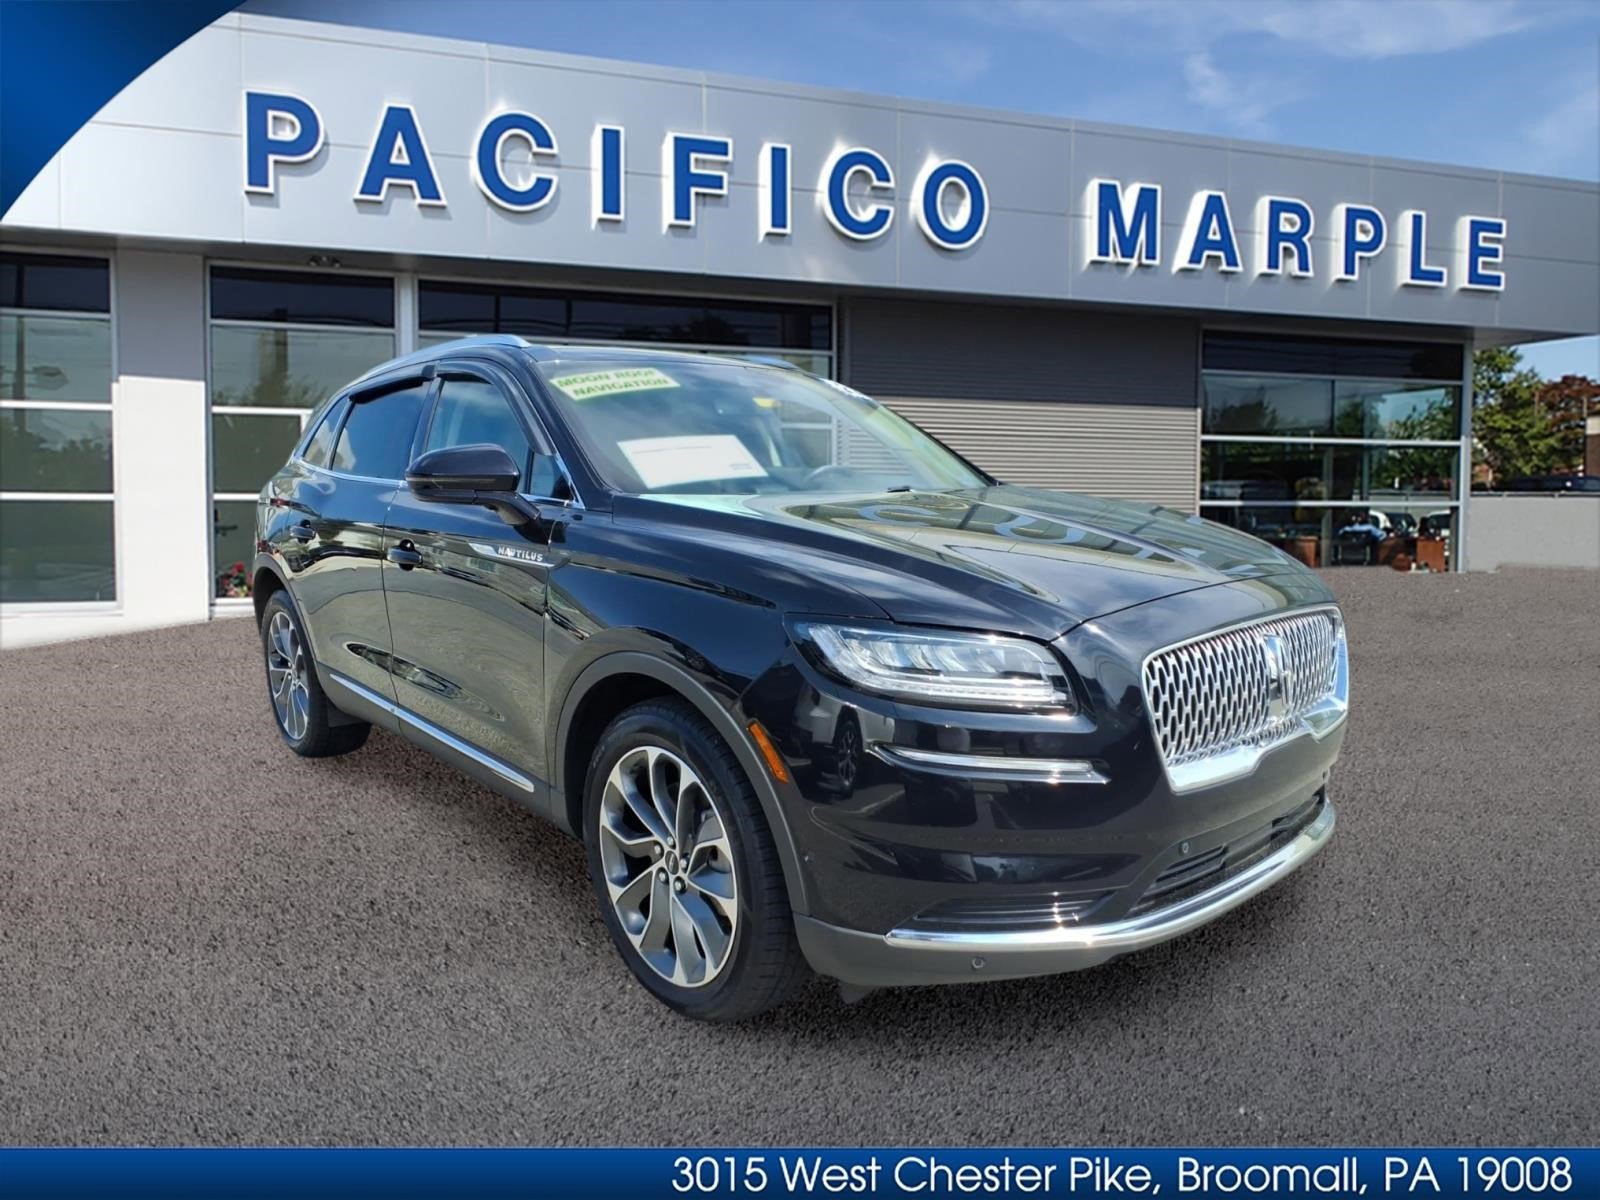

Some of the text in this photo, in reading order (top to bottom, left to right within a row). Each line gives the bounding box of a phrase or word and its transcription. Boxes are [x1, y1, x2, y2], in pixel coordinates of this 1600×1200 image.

[243, 89, 1507, 291] PACIFICO MARPLE
[557, 372, 611, 388] MOON
[572, 378, 670, 396] NAVIGATION
[498, 545, 544, 562] NAUTILUS
